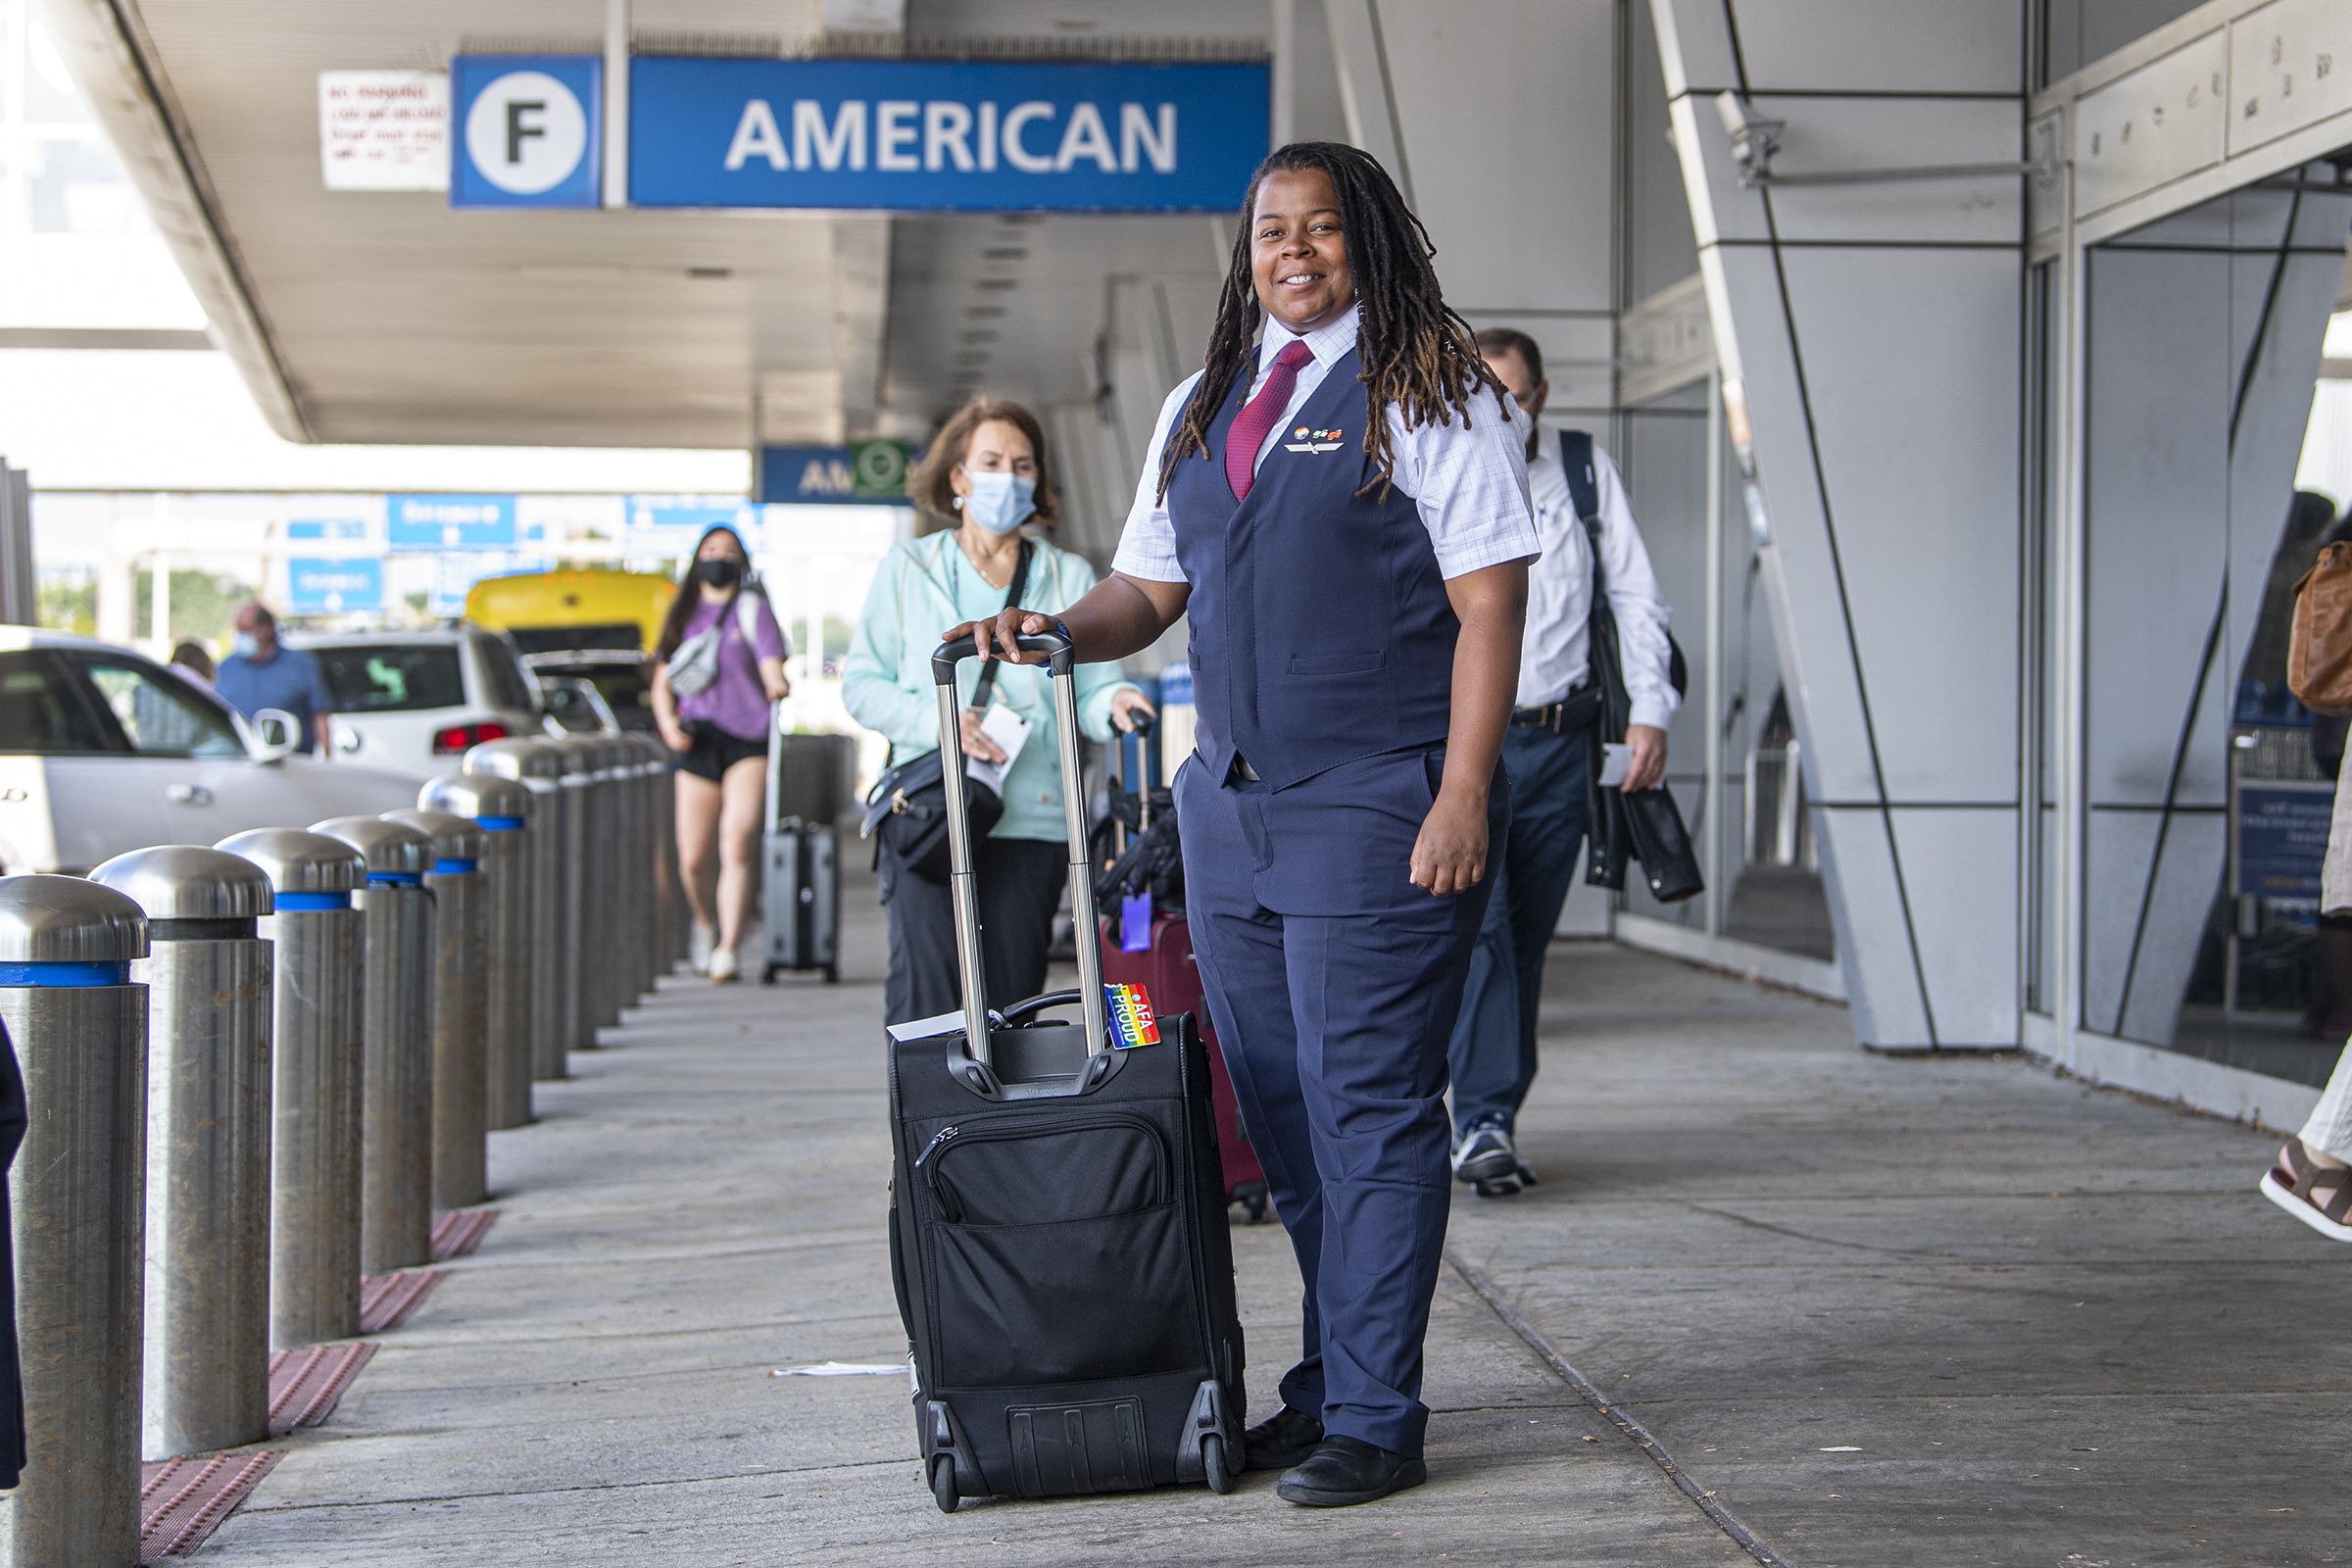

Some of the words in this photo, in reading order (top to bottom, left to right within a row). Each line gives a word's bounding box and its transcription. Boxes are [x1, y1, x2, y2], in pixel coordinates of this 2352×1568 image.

[506, 100, 546, 164] F
[724, 99, 1176, 173] AMERICAN
[1112, 995, 1140, 1043] PROUD
[1133, 1004, 1153, 1030] AFA
